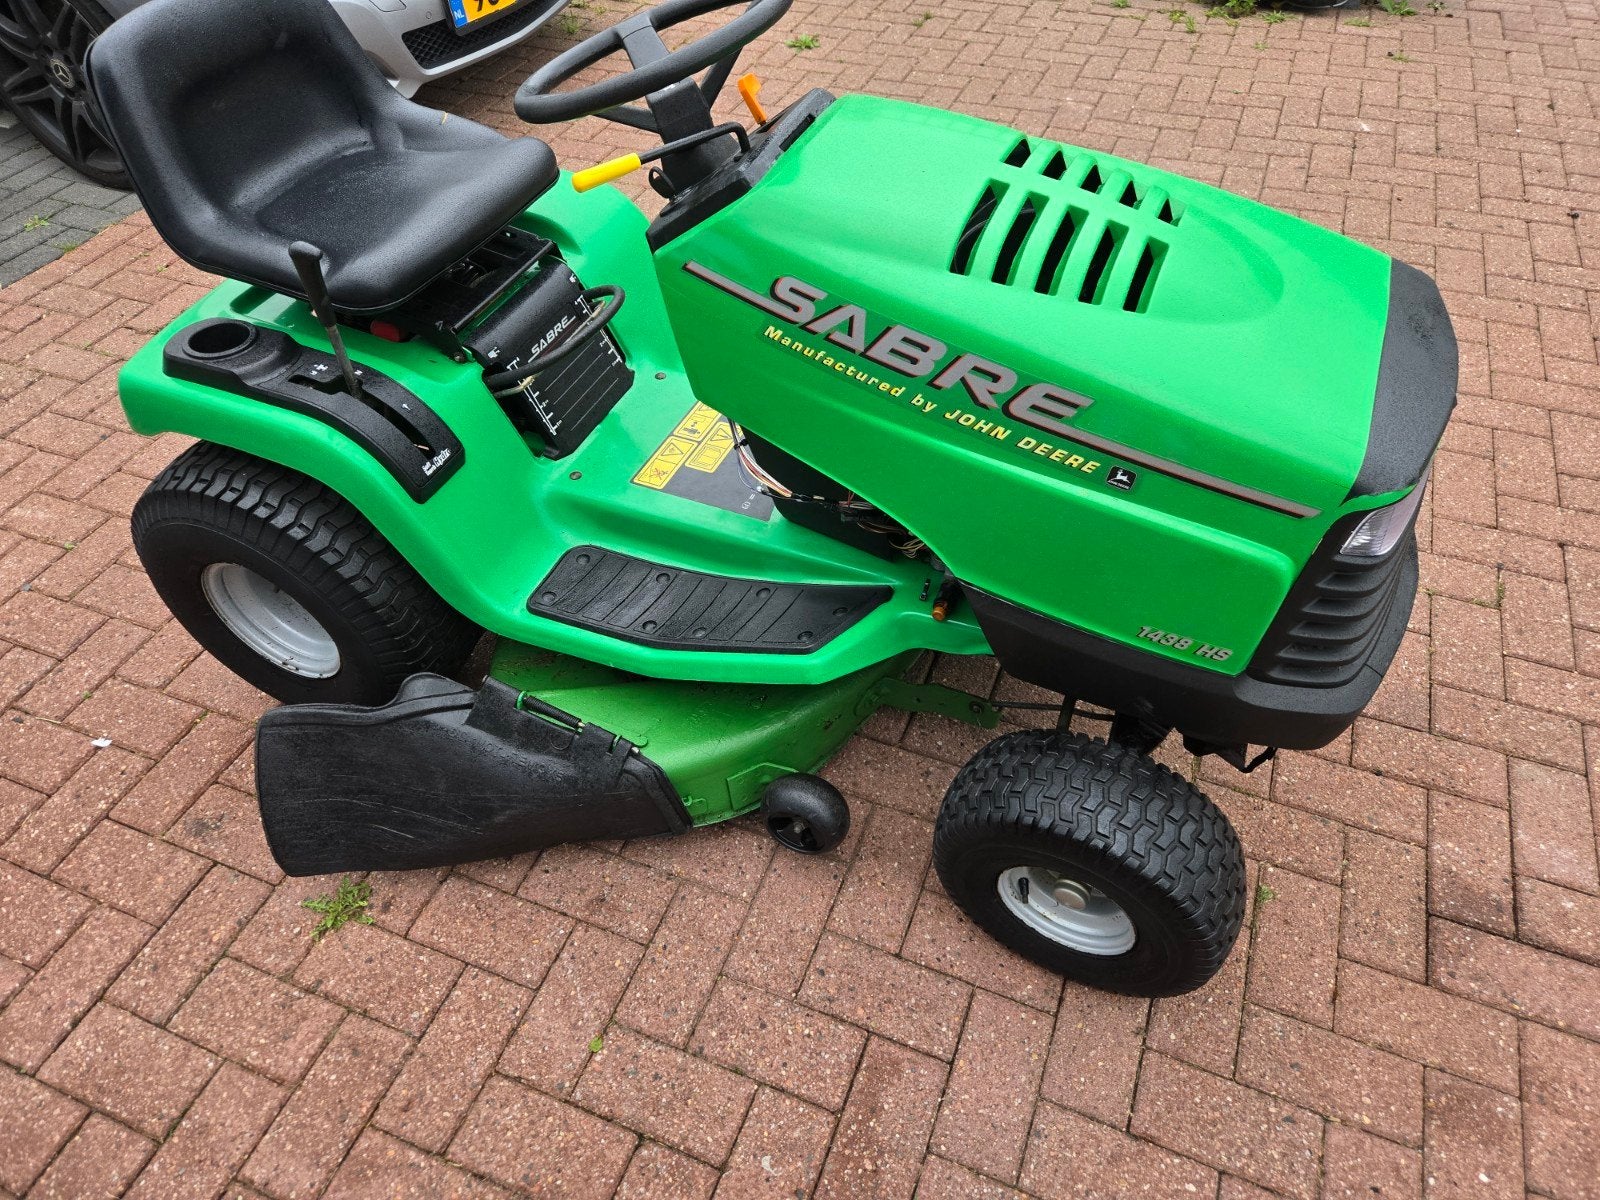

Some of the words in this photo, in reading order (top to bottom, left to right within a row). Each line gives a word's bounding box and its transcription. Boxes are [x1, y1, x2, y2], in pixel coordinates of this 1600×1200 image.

[453, 9, 465, 20] NL
[530, 315, 573, 358] SABRE
[770, 276, 1096, 435] SABRE
[764, 325, 906, 397] Manufactured
[910, 393, 937, 413] by
[945, 409, 1012, 441] JOHN
[1017, 437, 1101, 474] DEERE
[1136, 626, 1194, 650] 1438
[1194, 643, 1233, 661] HS
